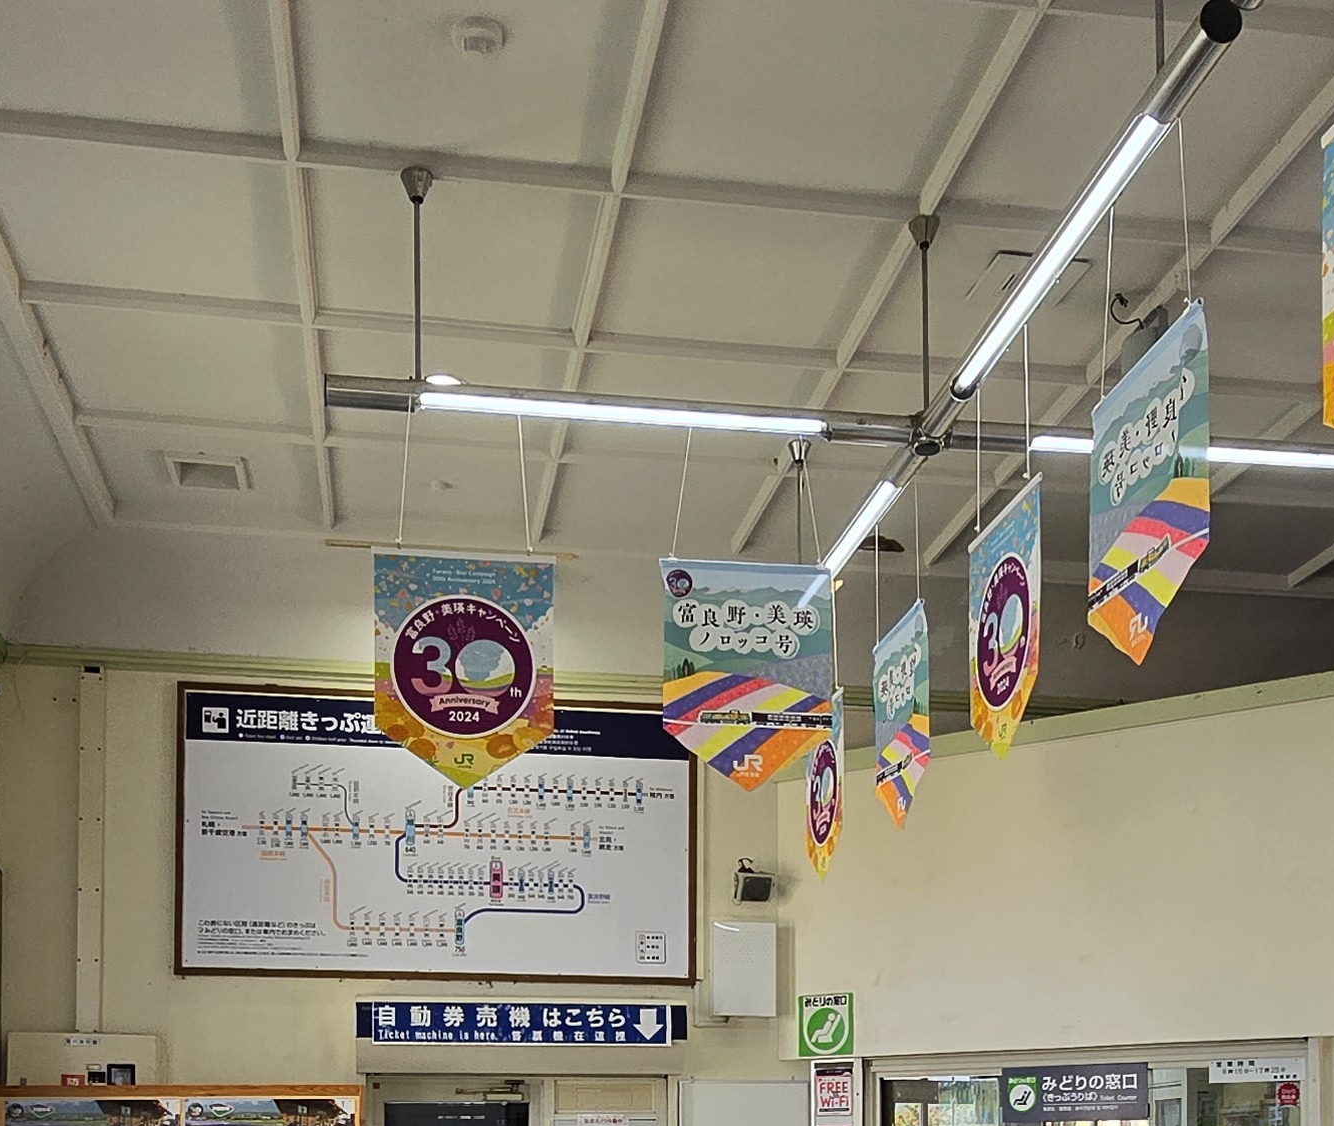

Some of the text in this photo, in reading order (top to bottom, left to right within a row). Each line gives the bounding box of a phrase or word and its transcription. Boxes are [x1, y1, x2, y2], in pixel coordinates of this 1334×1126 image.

[404, 602, 521, 643] 富良野・美瑛キャンペーン
[677, 602, 815, 631] 富良野・美瑛
[699, 632, 794, 655] ノロッコ号
[438, 695, 491, 708] Anniversary
[448, 710, 481, 723] 2024
[453, 752, 475, 766] JR
[732, 753, 764, 773] JR
[805, 995, 848, 1008] みどりの窓口
[377, 1005, 627, 1029] 自動券売機はこちら
[377, 1028, 411, 1042] Ticket
[414, 1029, 454, 1042] machine
[458, 1030, 469, 1042] is
[819, 1081, 849, 1095] FREE
[1041, 1073, 1138, 1092] みどりの窓口
[819, 1094, 850, 1109] Wi-Fi
